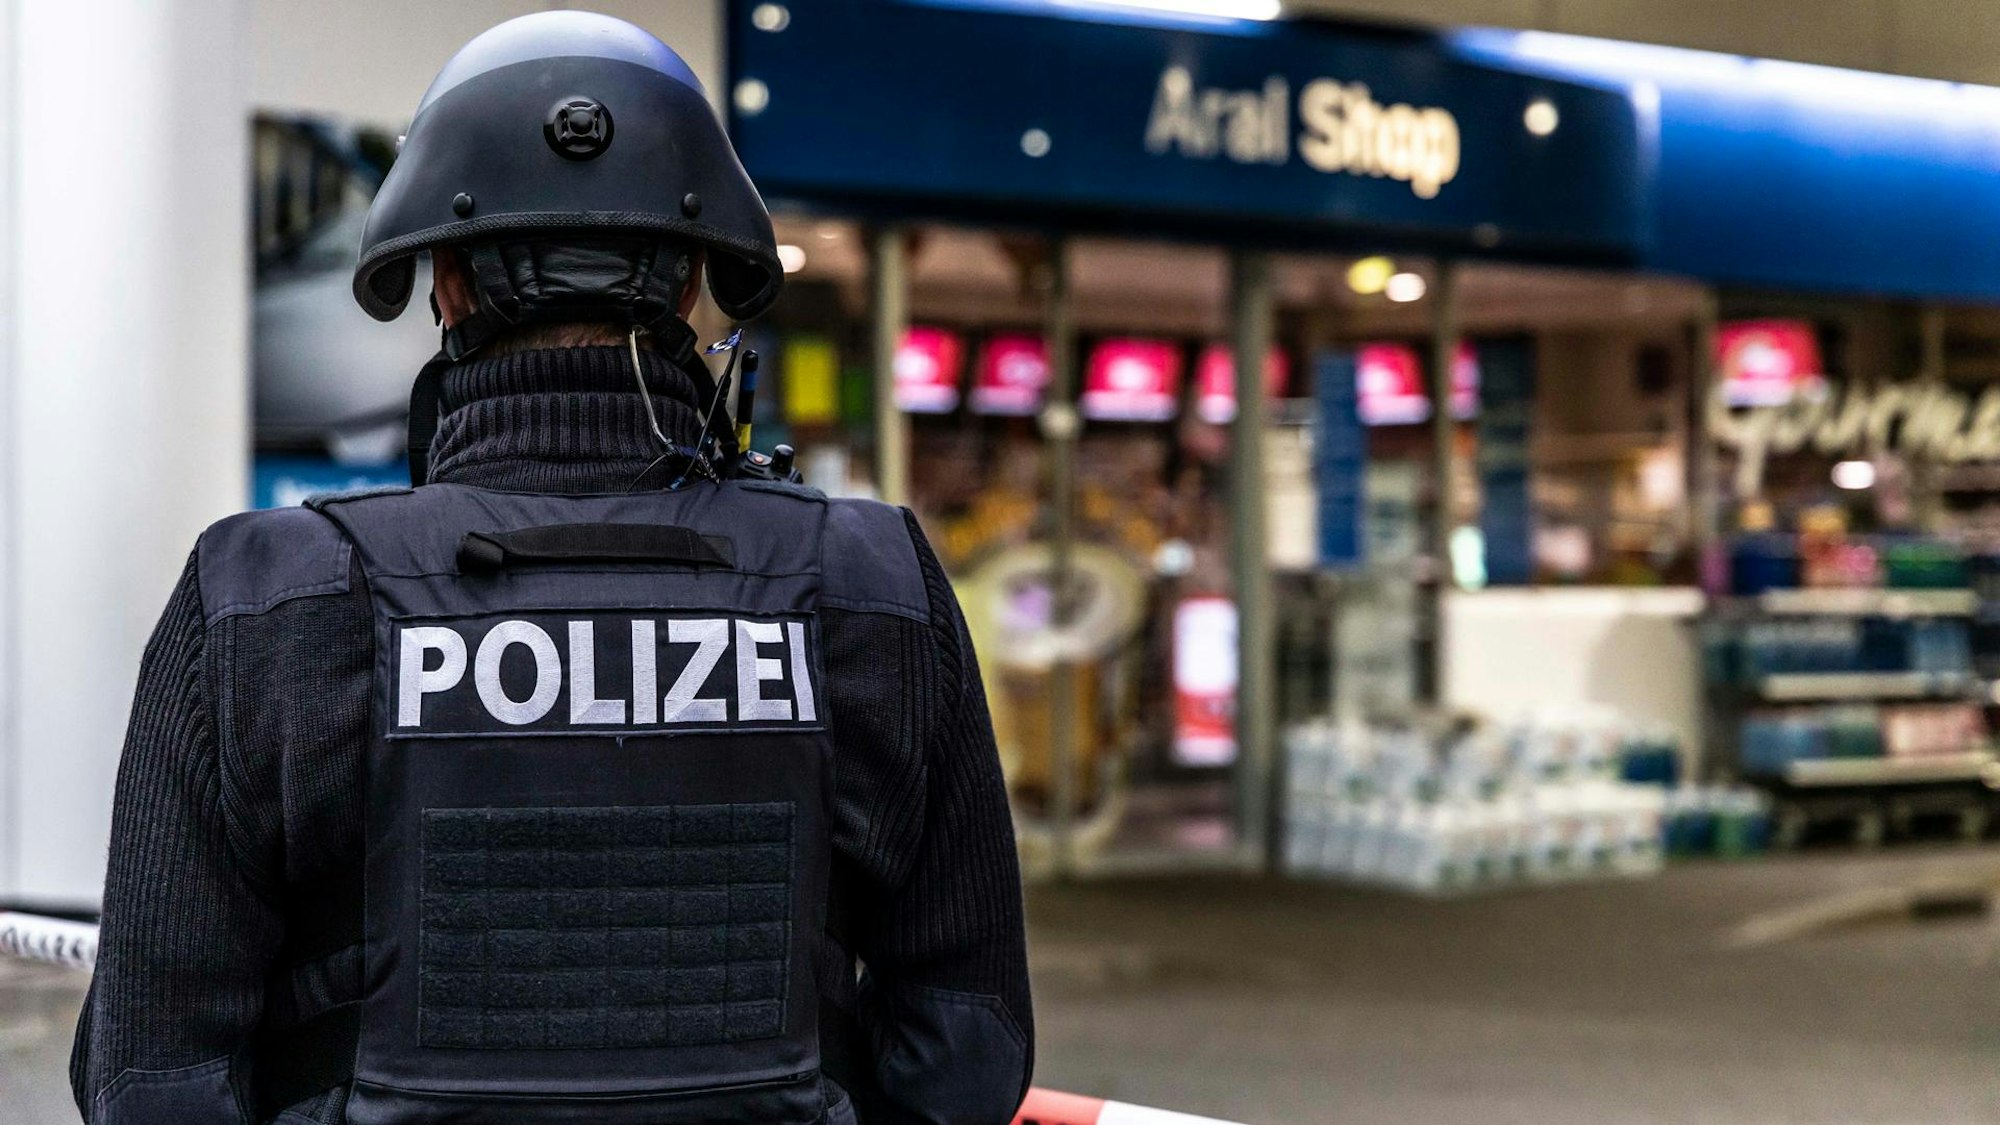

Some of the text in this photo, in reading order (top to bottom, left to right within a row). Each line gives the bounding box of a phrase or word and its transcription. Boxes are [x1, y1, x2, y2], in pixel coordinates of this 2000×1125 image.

[1145, 65, 1460, 199] Aral Shop
[398, 619, 817, 727] POLIZEI
